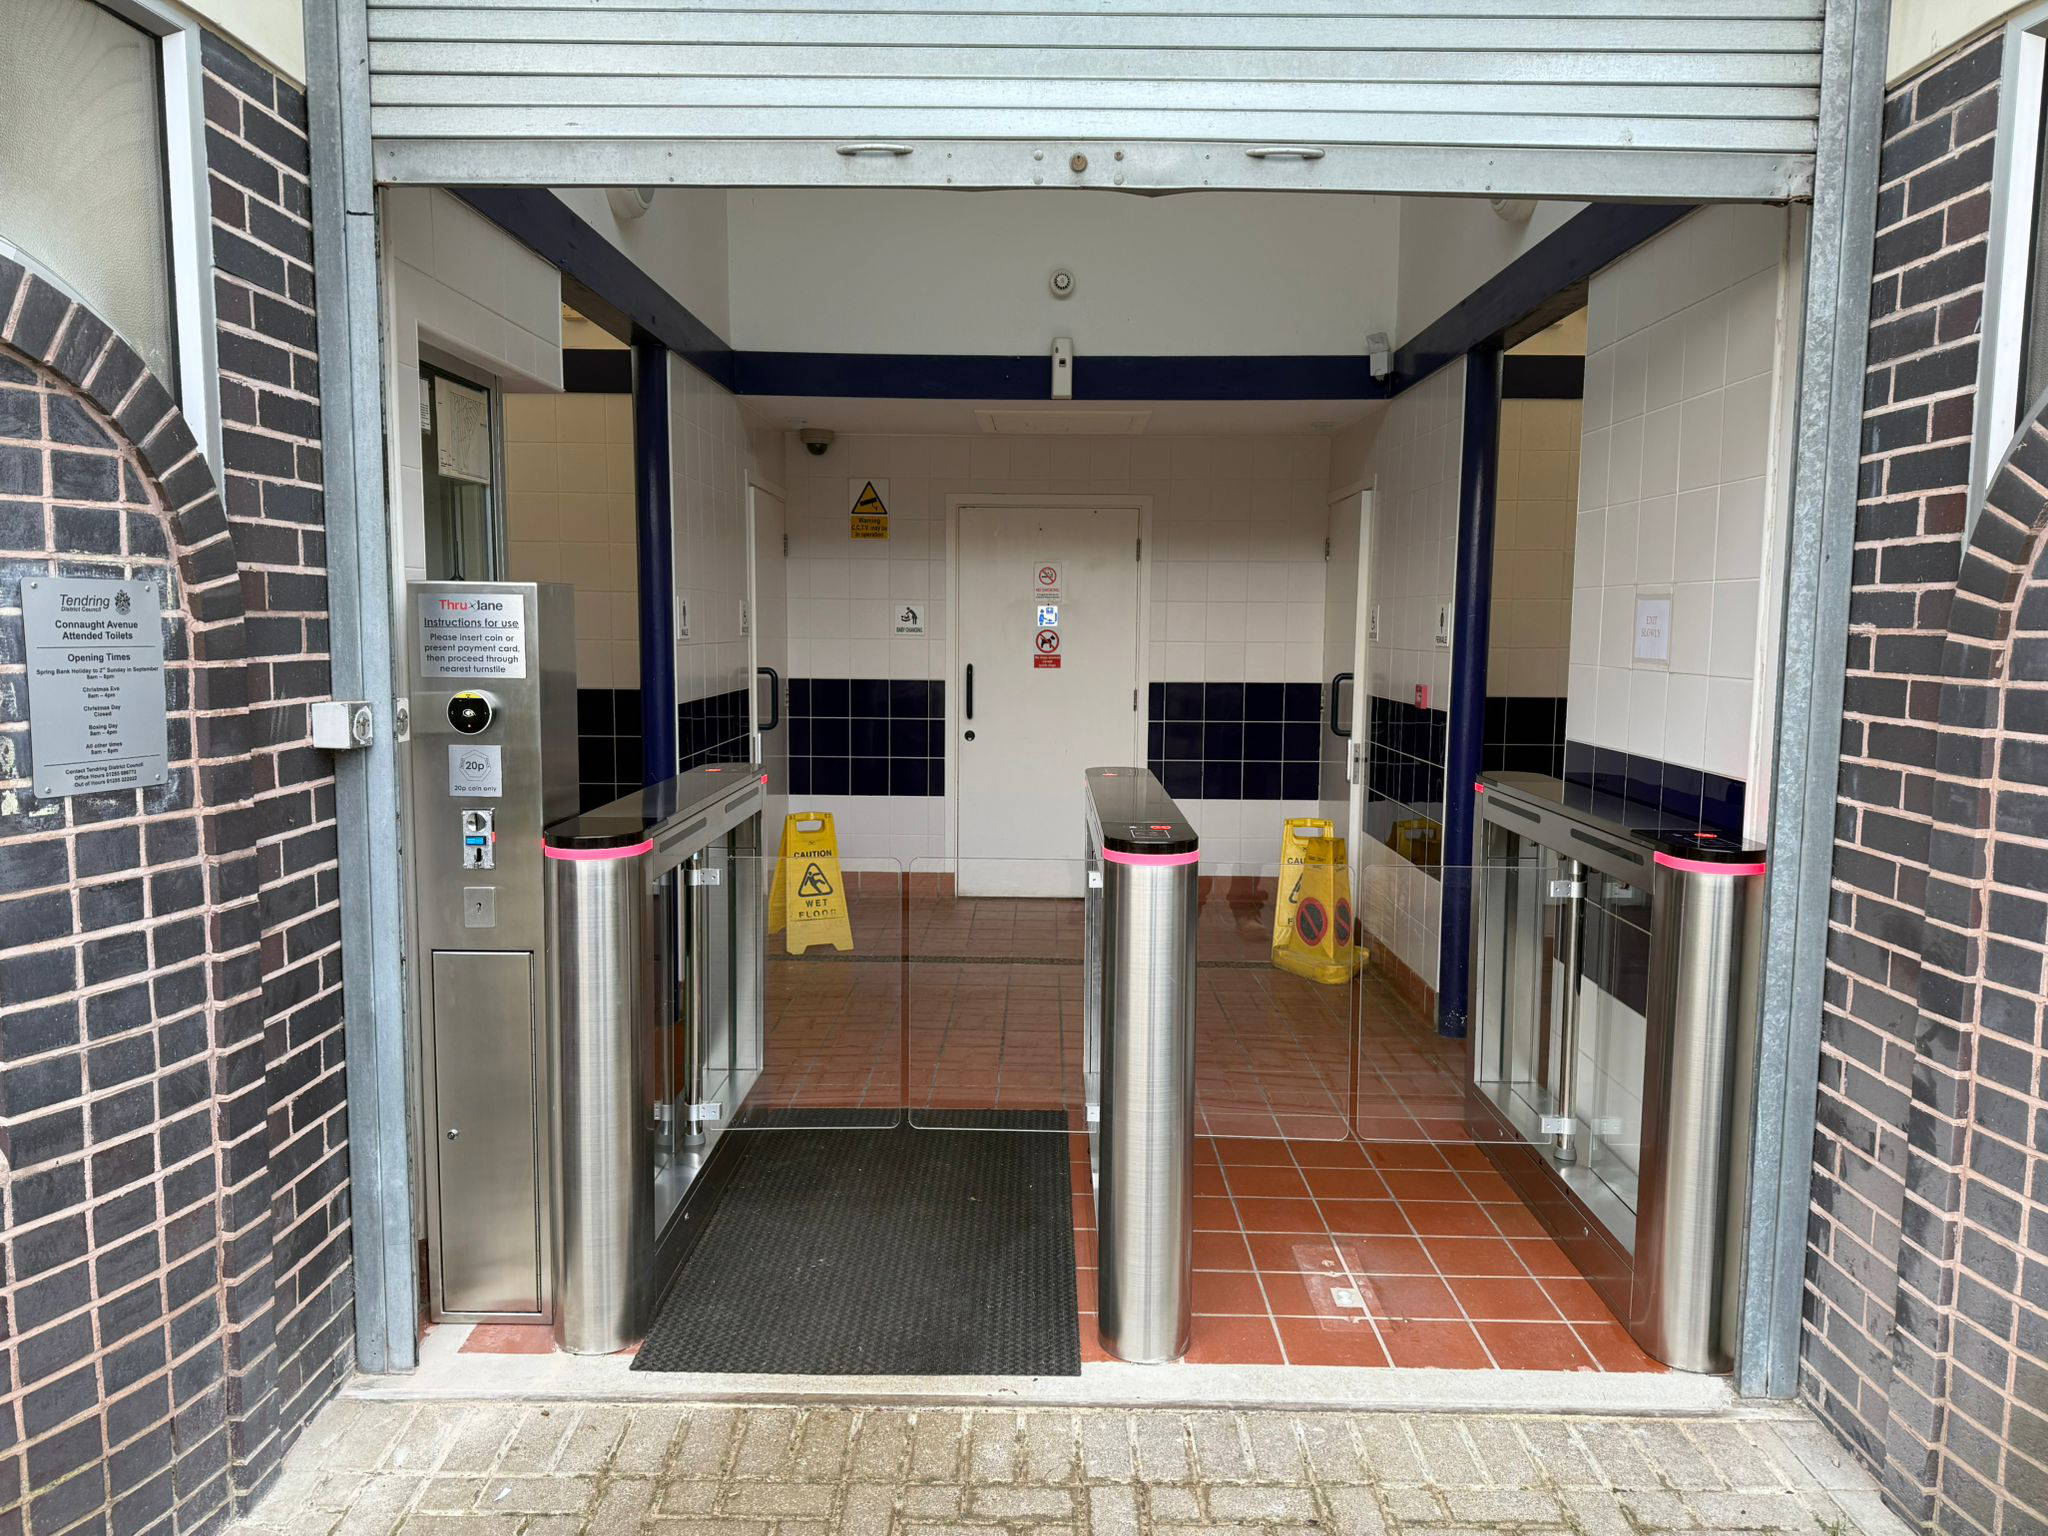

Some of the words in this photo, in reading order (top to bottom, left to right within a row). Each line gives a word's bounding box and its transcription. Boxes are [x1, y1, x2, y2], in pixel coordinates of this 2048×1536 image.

[60, 594, 110, 609] Tendring
[438, 600, 468, 610] Thru
[477, 600, 503, 611] lane
[55, 620, 104, 631] Connaught
[107, 620, 138, 629] Avenue
[424, 618, 482, 628] Instructions
[484, 618, 498, 628] for
[62, 631, 103, 640] Attended
[105, 631, 133, 640] Toilets
[424, 644, 455, 653] present
[458, 644, 496, 653] payment
[498, 645, 520, 653] card,
[67, 653, 104, 663] Opening
[106, 653, 131, 661] Times
[426, 654, 446, 662] then
[448, 655, 484, 663] proceed
[486, 655, 518, 664] through
[440, 665, 471, 673] nearest
[473, 665, 506, 673] turnstile
[465, 761, 485, 771] 20p
[794, 850, 832, 859] CAUTION
[806, 899, 828, 908] WET
